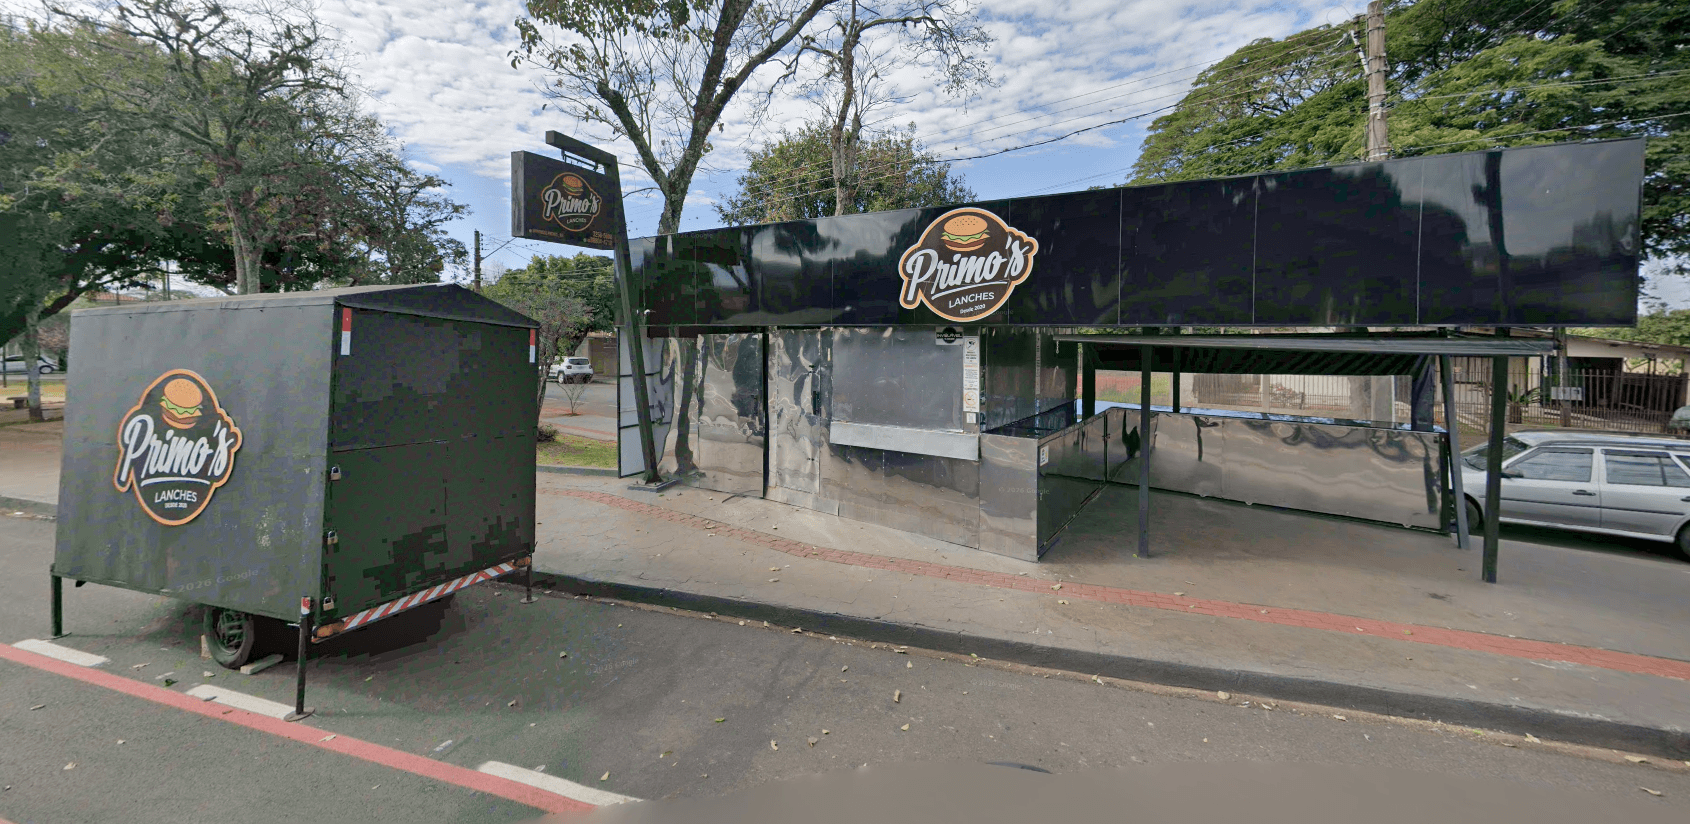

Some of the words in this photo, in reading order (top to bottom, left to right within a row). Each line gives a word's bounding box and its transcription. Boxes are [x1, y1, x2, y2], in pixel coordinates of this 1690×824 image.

[545, 189, 599, 217] Primo's
[906, 235, 1030, 301] Primo's
[949, 292, 995, 308] LANCHES
[120, 414, 234, 482] Primo's
[154, 489, 198, 503] LANCHES
